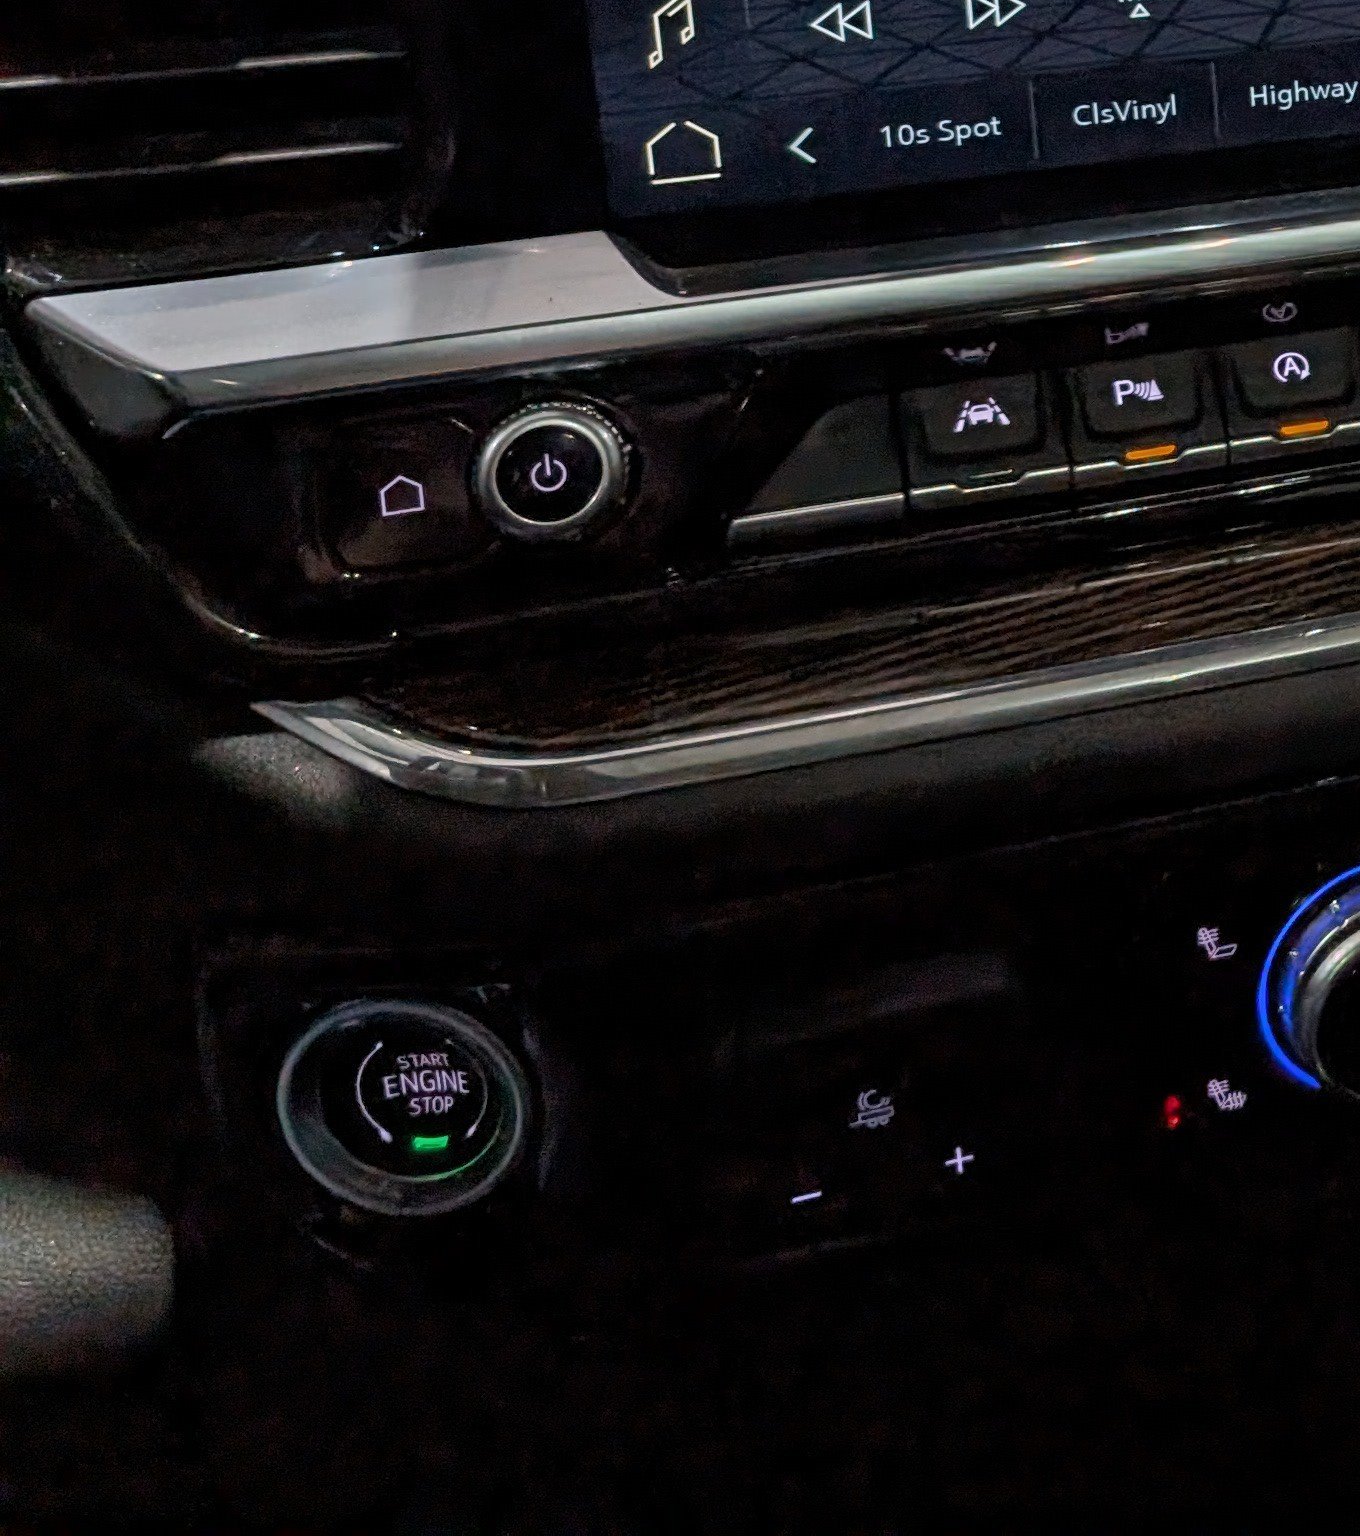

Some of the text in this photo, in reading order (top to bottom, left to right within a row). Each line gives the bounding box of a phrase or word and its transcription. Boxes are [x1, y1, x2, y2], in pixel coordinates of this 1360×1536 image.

[1072, 93, 1177, 126] ClsVinyl
[1249, 80, 1359, 111] Highway
[880, 116, 1002, 148] 10s Spot
[1112, 379, 1134, 406] P
[396, 1052, 450, 1069] START
[383, 1069, 471, 1100] ENGINE
[407, 1095, 455, 1116] STOP
